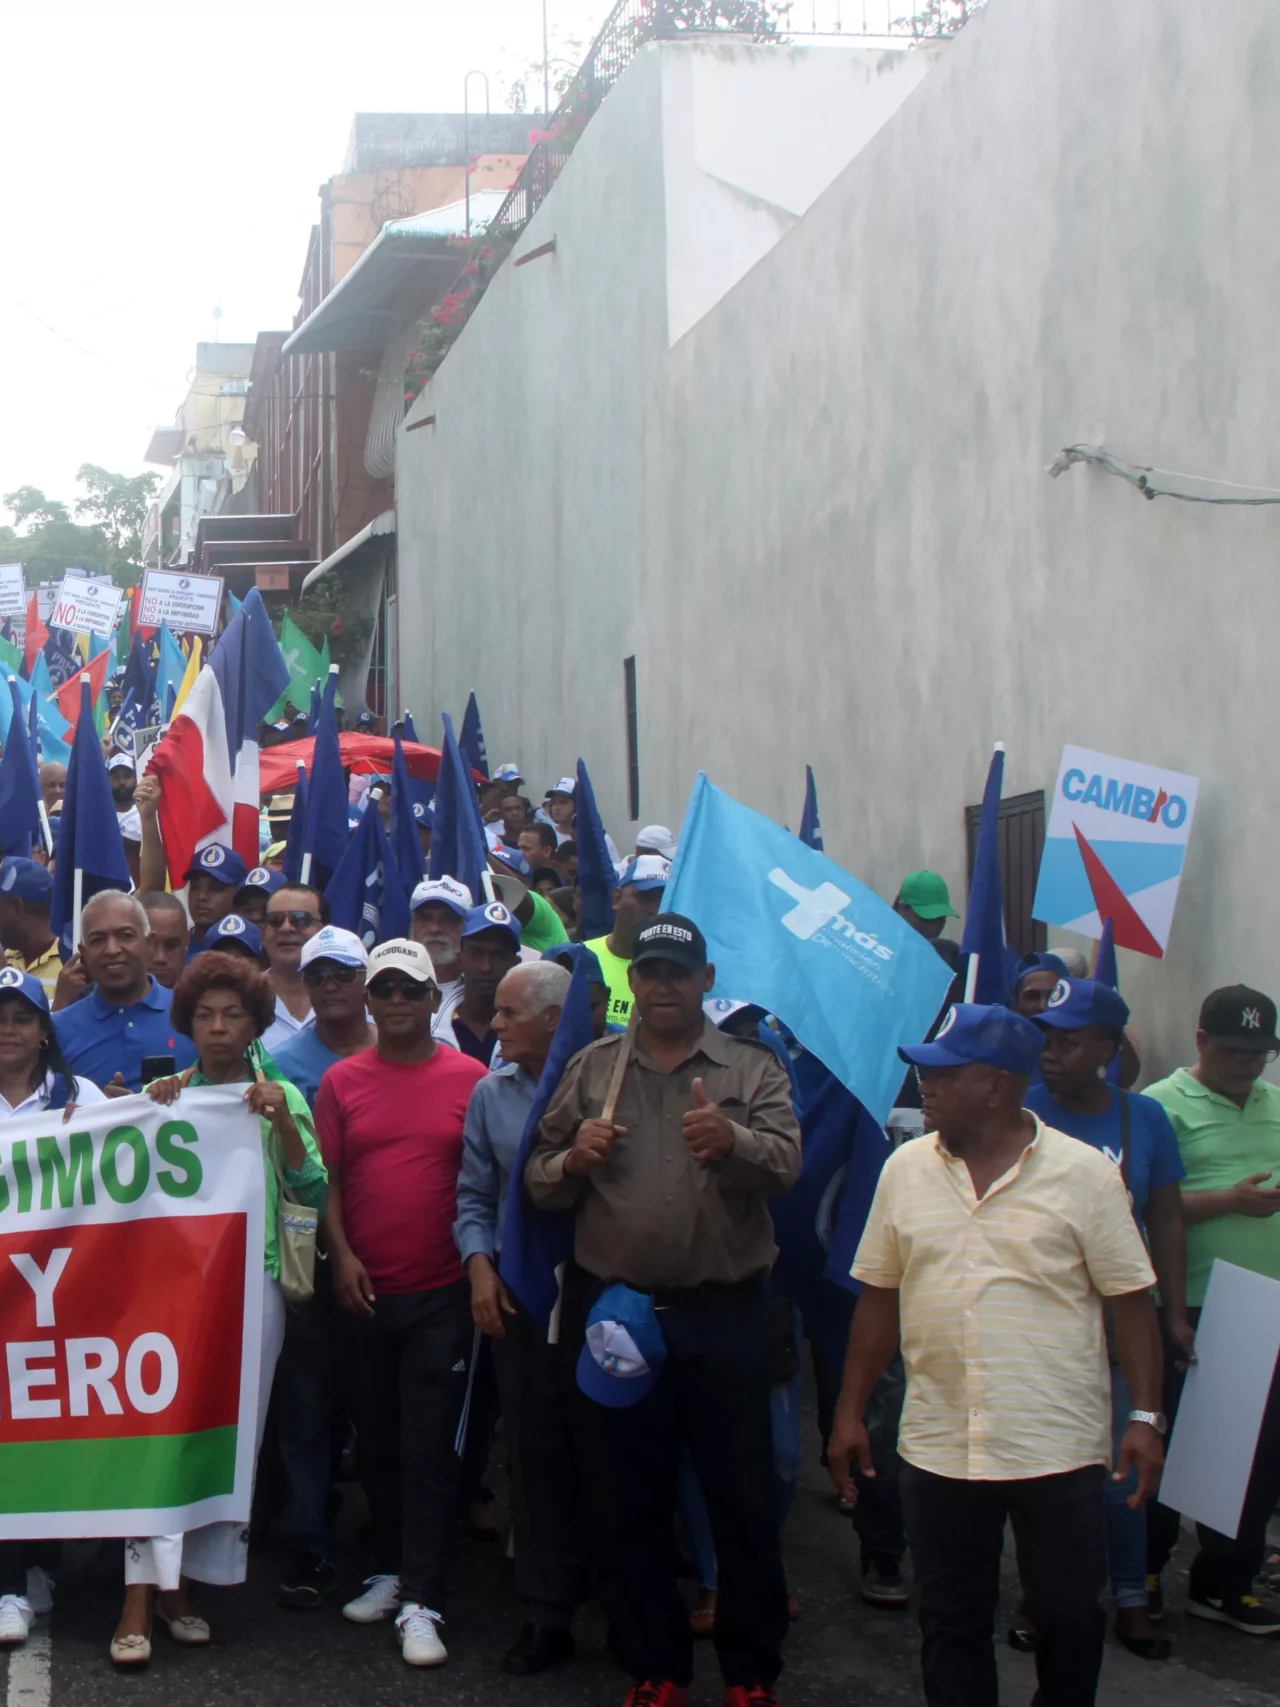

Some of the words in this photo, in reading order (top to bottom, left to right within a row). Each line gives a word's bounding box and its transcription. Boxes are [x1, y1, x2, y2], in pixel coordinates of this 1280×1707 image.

[143, 606, 157, 614] NO
[145, 596, 158, 605] NO
[54, 601, 76, 626] NO
[142, 614, 155, 622] NO
[51, 651, 77, 673] PRM
[1061, 767, 1188, 829] CAMBIO
[638, 924, 662, 941] PONTE
[662, 923, 673, 934] EN
[673, 926, 693, 942] ESTO
[831, 913, 895, 961] más
[381, 945, 418, 958] COUGARS
[613, 999, 629, 1015] EN
[8, 1247, 73, 1328] Y
